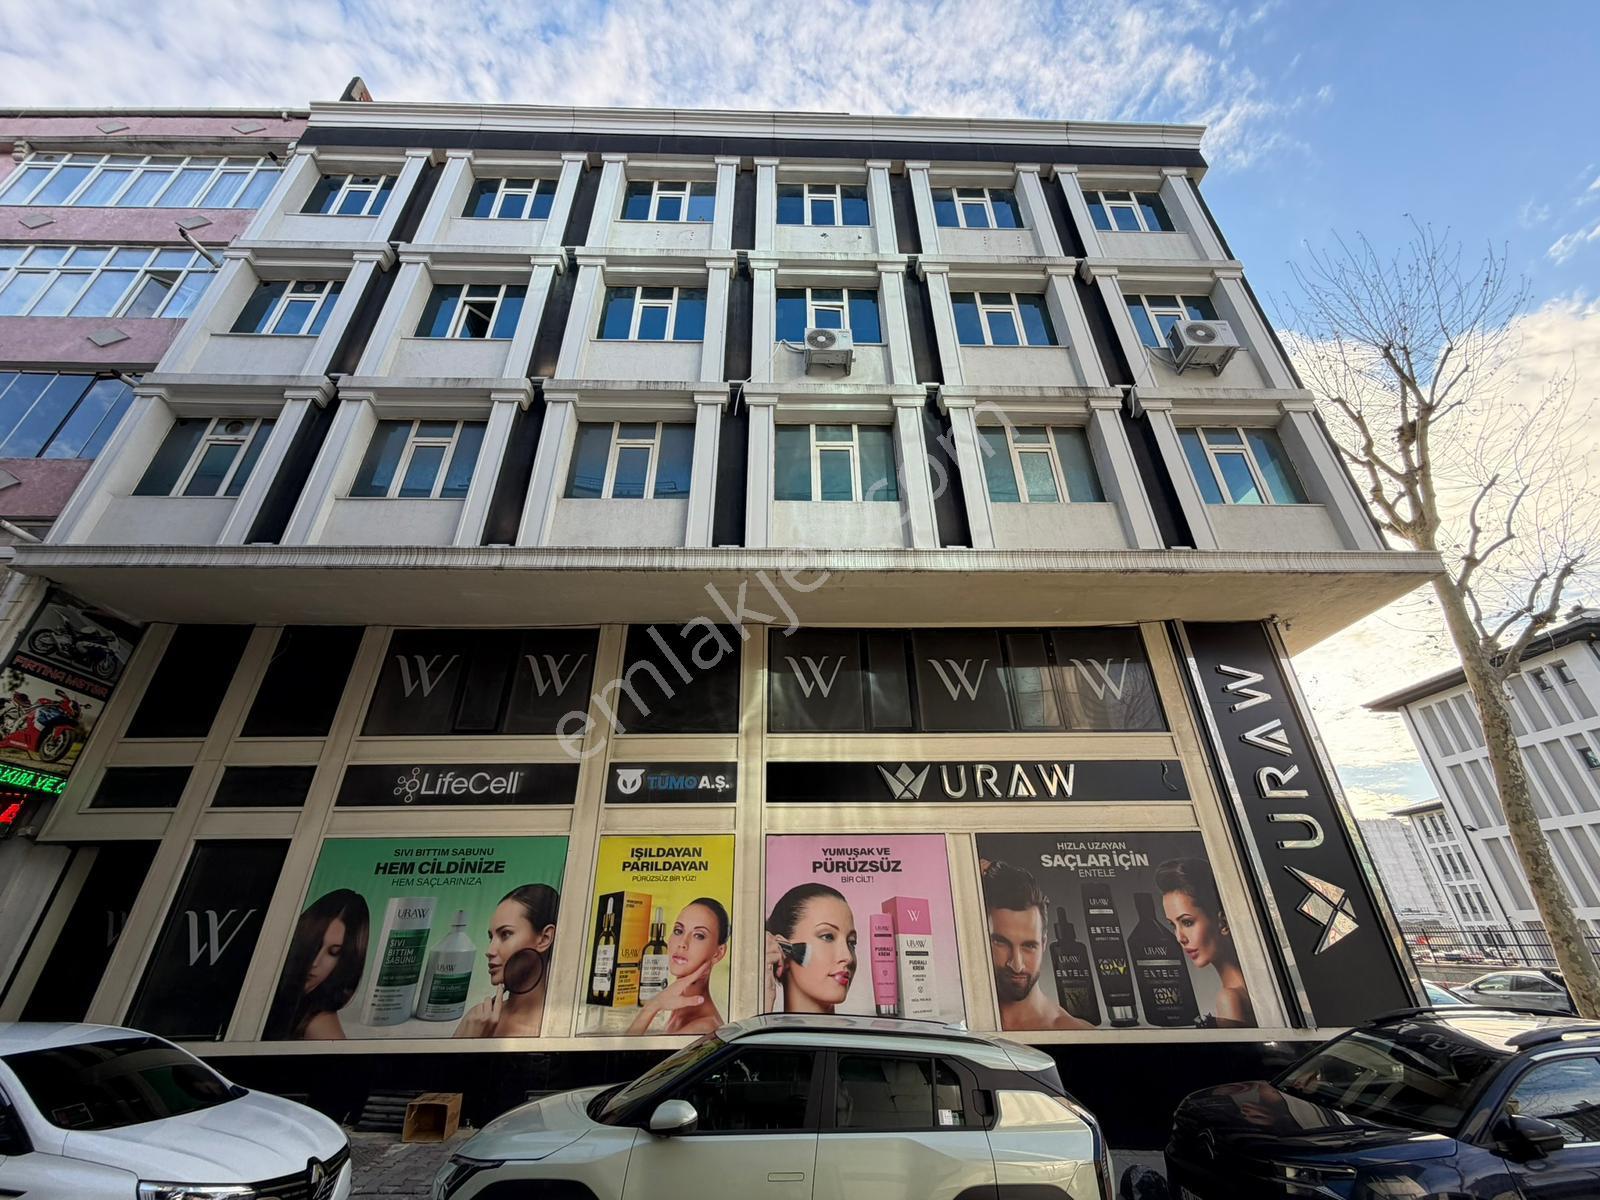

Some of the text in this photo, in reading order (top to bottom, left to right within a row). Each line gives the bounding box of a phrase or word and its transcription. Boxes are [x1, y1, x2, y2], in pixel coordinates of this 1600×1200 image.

[395, 654, 460, 697] W
[524, 654, 588, 697] W
[784, 655, 847, 698] W
[927, 658, 990, 701] W
[1069, 658, 1131, 700] W
[1215, 664, 1325, 849] URAW
[420, 771, 519, 794] LifeCell
[939, 763, 1075, 799] URAW
[393, 848, 413, 857] SIVI
[451, 848, 495, 856] SABUNU
[630, 847, 702, 861] IŞILDAYAN
[821, 847, 891, 858] YUMUŞAK VE
[1057, 841, 1126, 850] HIZLA UZAYAN
[374, 857, 506, 875] HEM CİLDİNİZE
[622, 860, 709, 872] PARILDAYAN
[812, 857, 903, 873] PÜRÜZSÜZ
[1040, 850, 1150, 871] SAÇLAR İÇİN
[632, 873, 669, 882] PÜRÜZSÜZ
[840, 874, 854, 883] BİR
[1078, 868, 1116, 878] ENTELE
[391, 876, 482, 888] HEM SAÇLARINIZA
